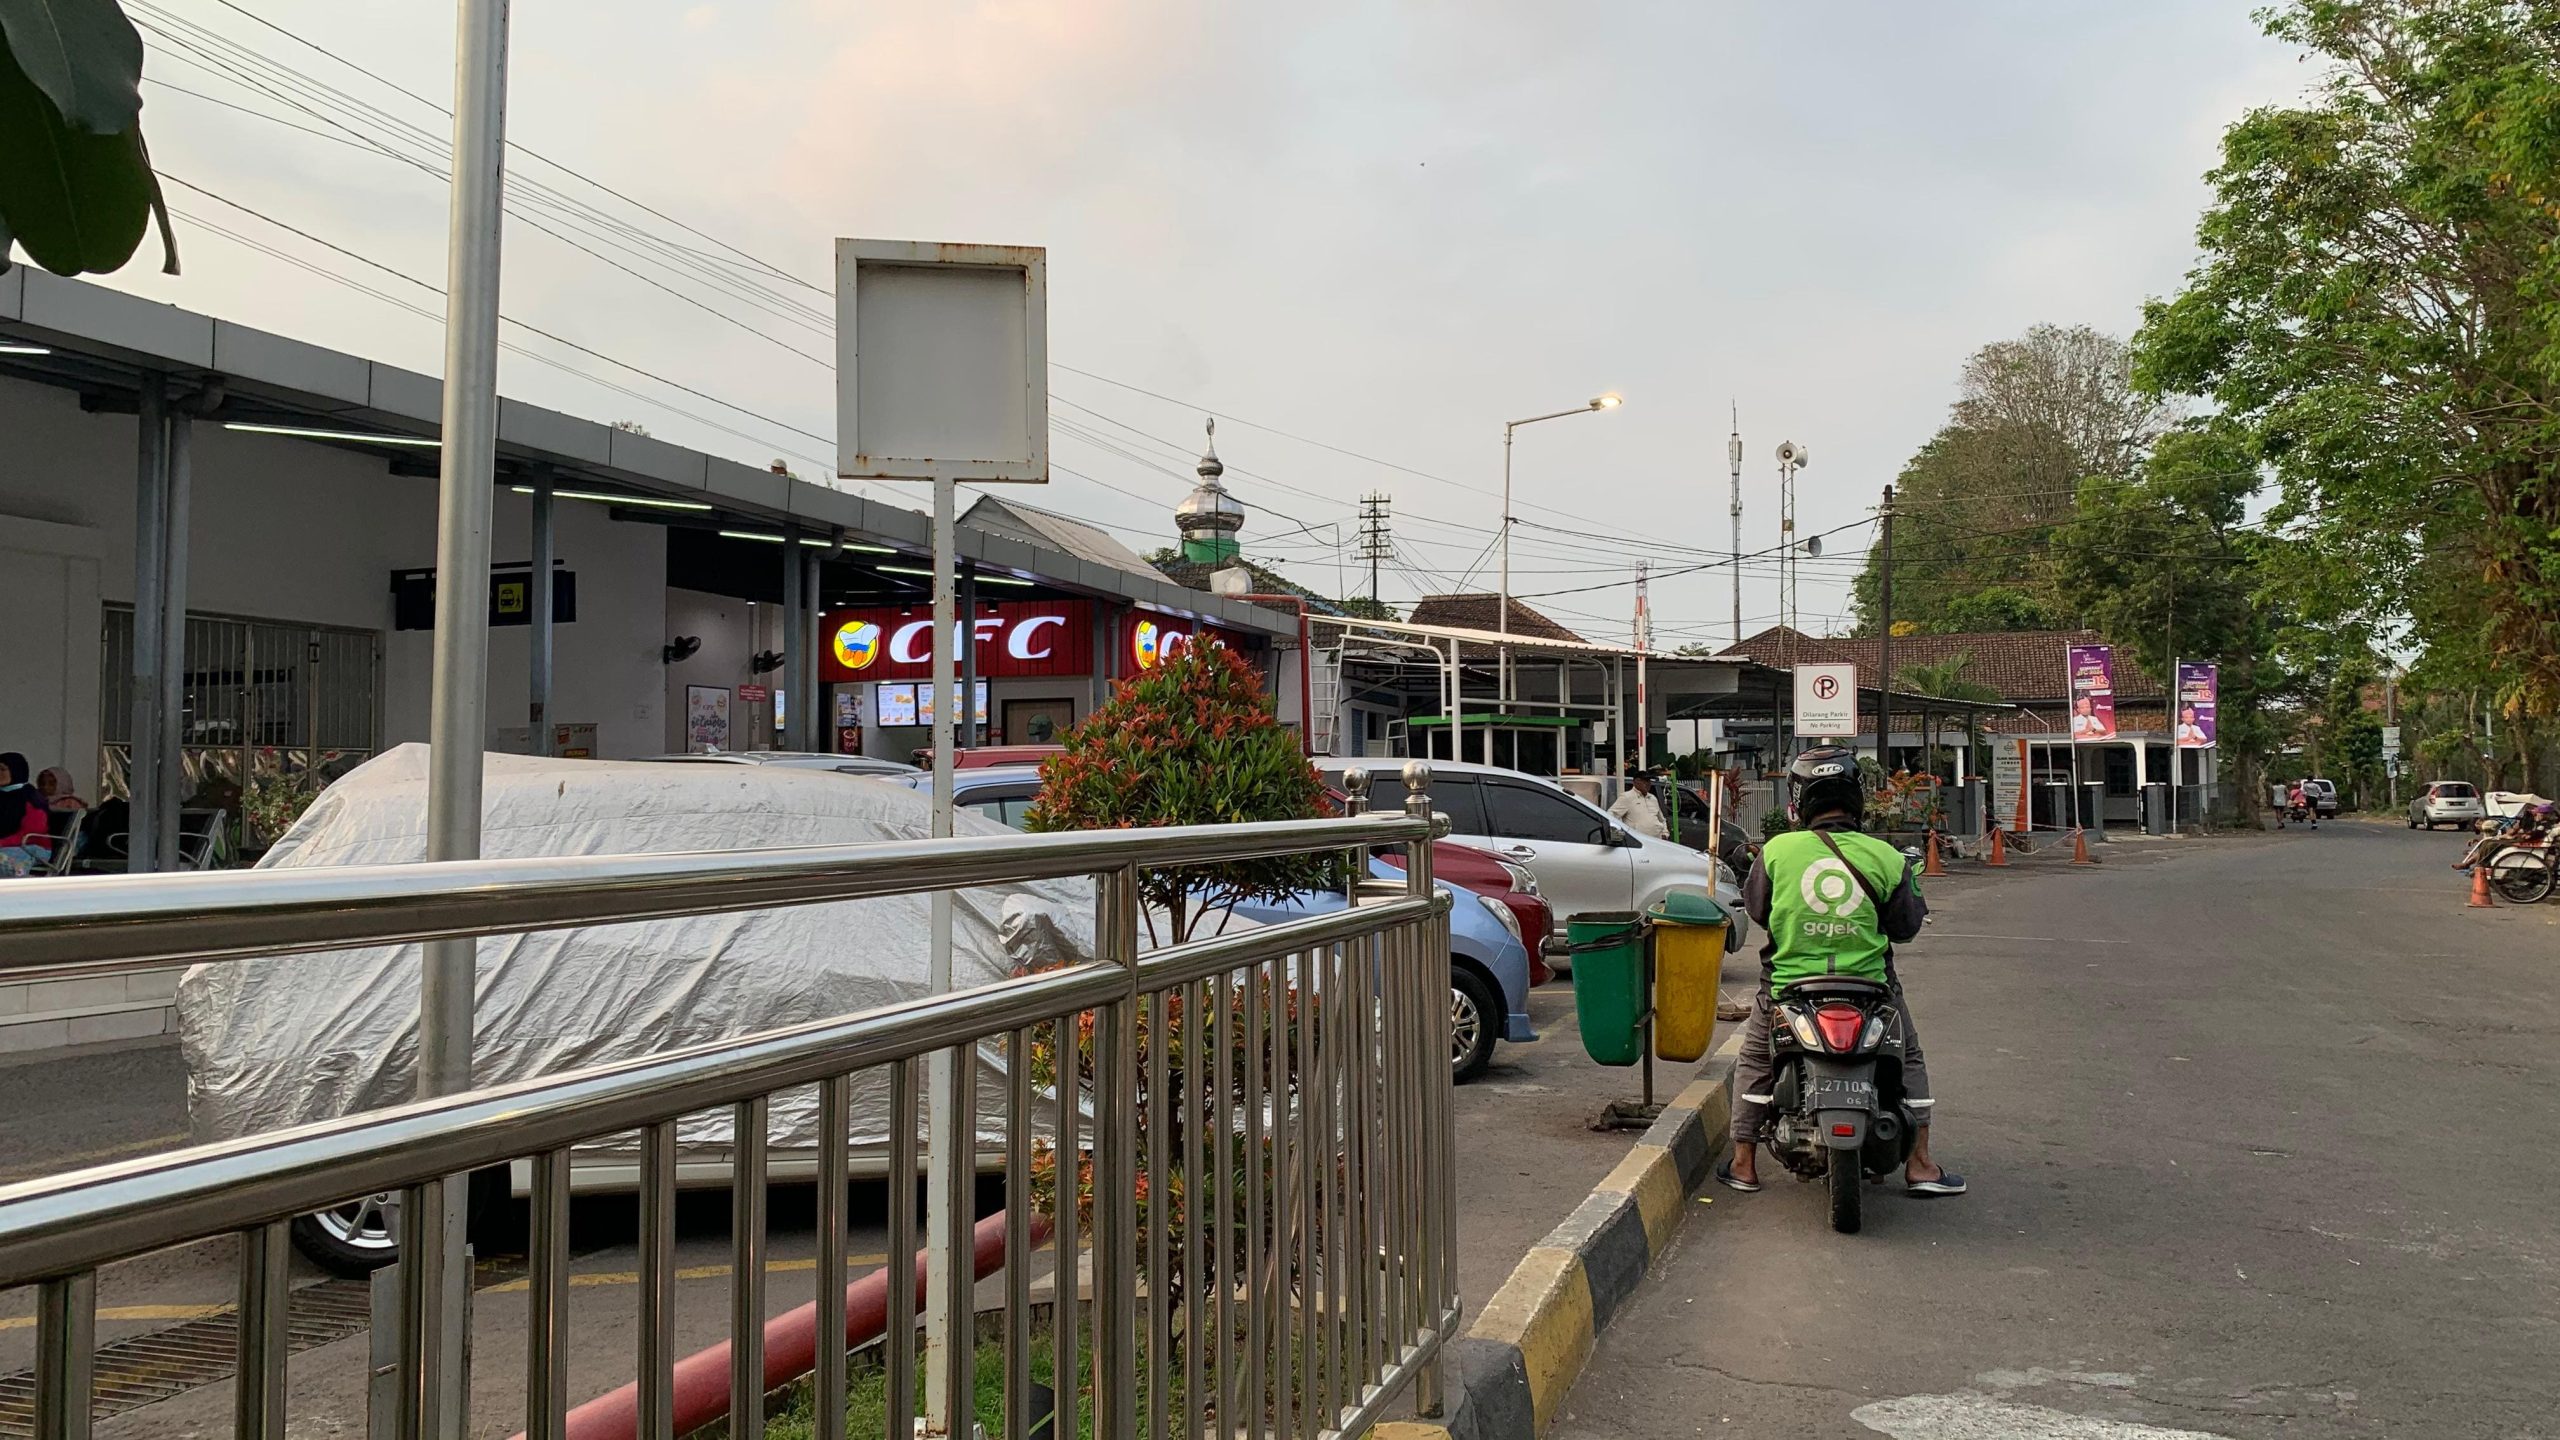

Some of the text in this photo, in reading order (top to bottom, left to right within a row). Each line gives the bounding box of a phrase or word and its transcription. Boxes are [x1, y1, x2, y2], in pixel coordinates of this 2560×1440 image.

[889, 616, 1066, 664] CFC
[1802, 711, 1828, 719] Dilarang
[1803, 921, 1858, 938] gojek
